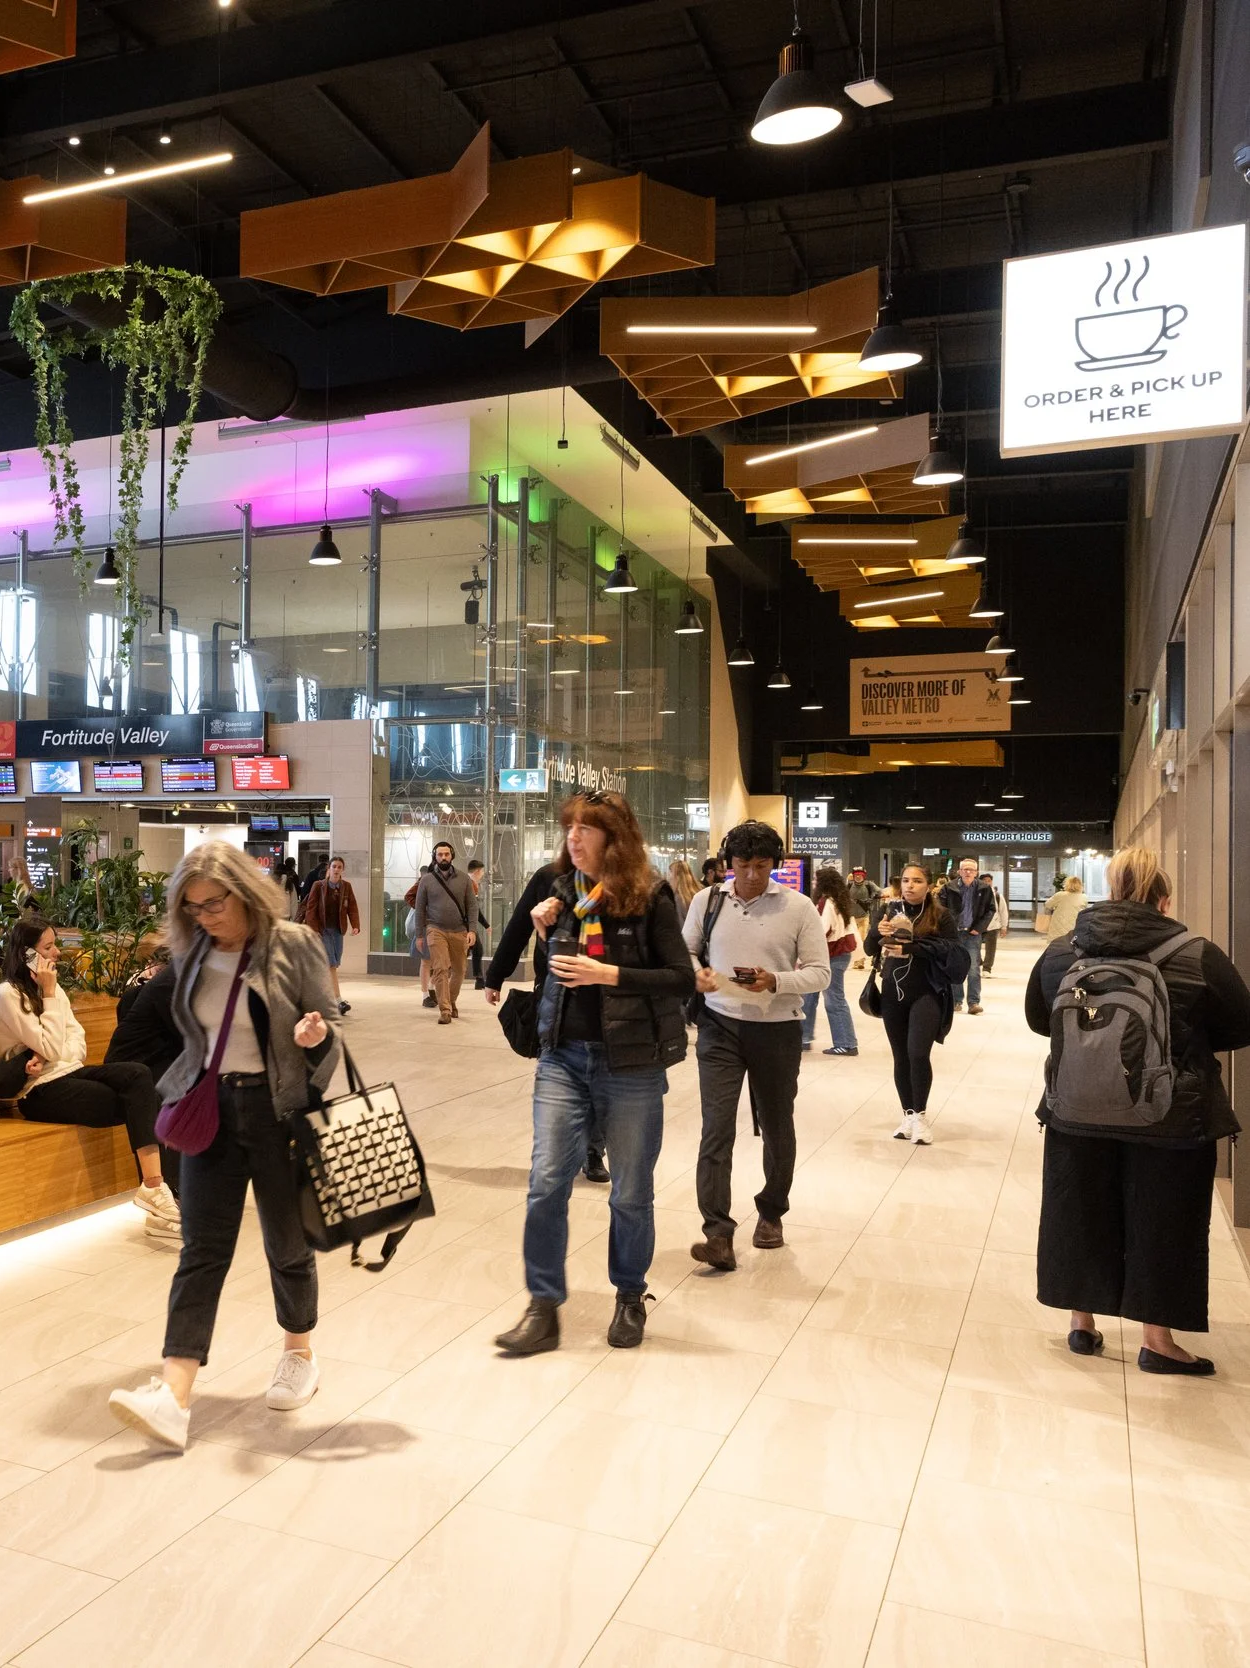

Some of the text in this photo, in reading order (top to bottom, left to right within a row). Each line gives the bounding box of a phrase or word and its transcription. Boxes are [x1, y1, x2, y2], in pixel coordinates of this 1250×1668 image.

[1024, 371, 1223, 408] ORDER & PICK UP
[1089, 403, 1152, 423] HERE
[862, 679, 966, 699] DISCOVER MORE OF
[862, 697, 940, 716] VALLEY METRO
[42, 727, 170, 747] Fortitude Valley
[577, 760, 600, 791] Valley
[601, 766, 626, 794] Station
[963, 832, 1051, 841] TRANSPORT HOUSE
